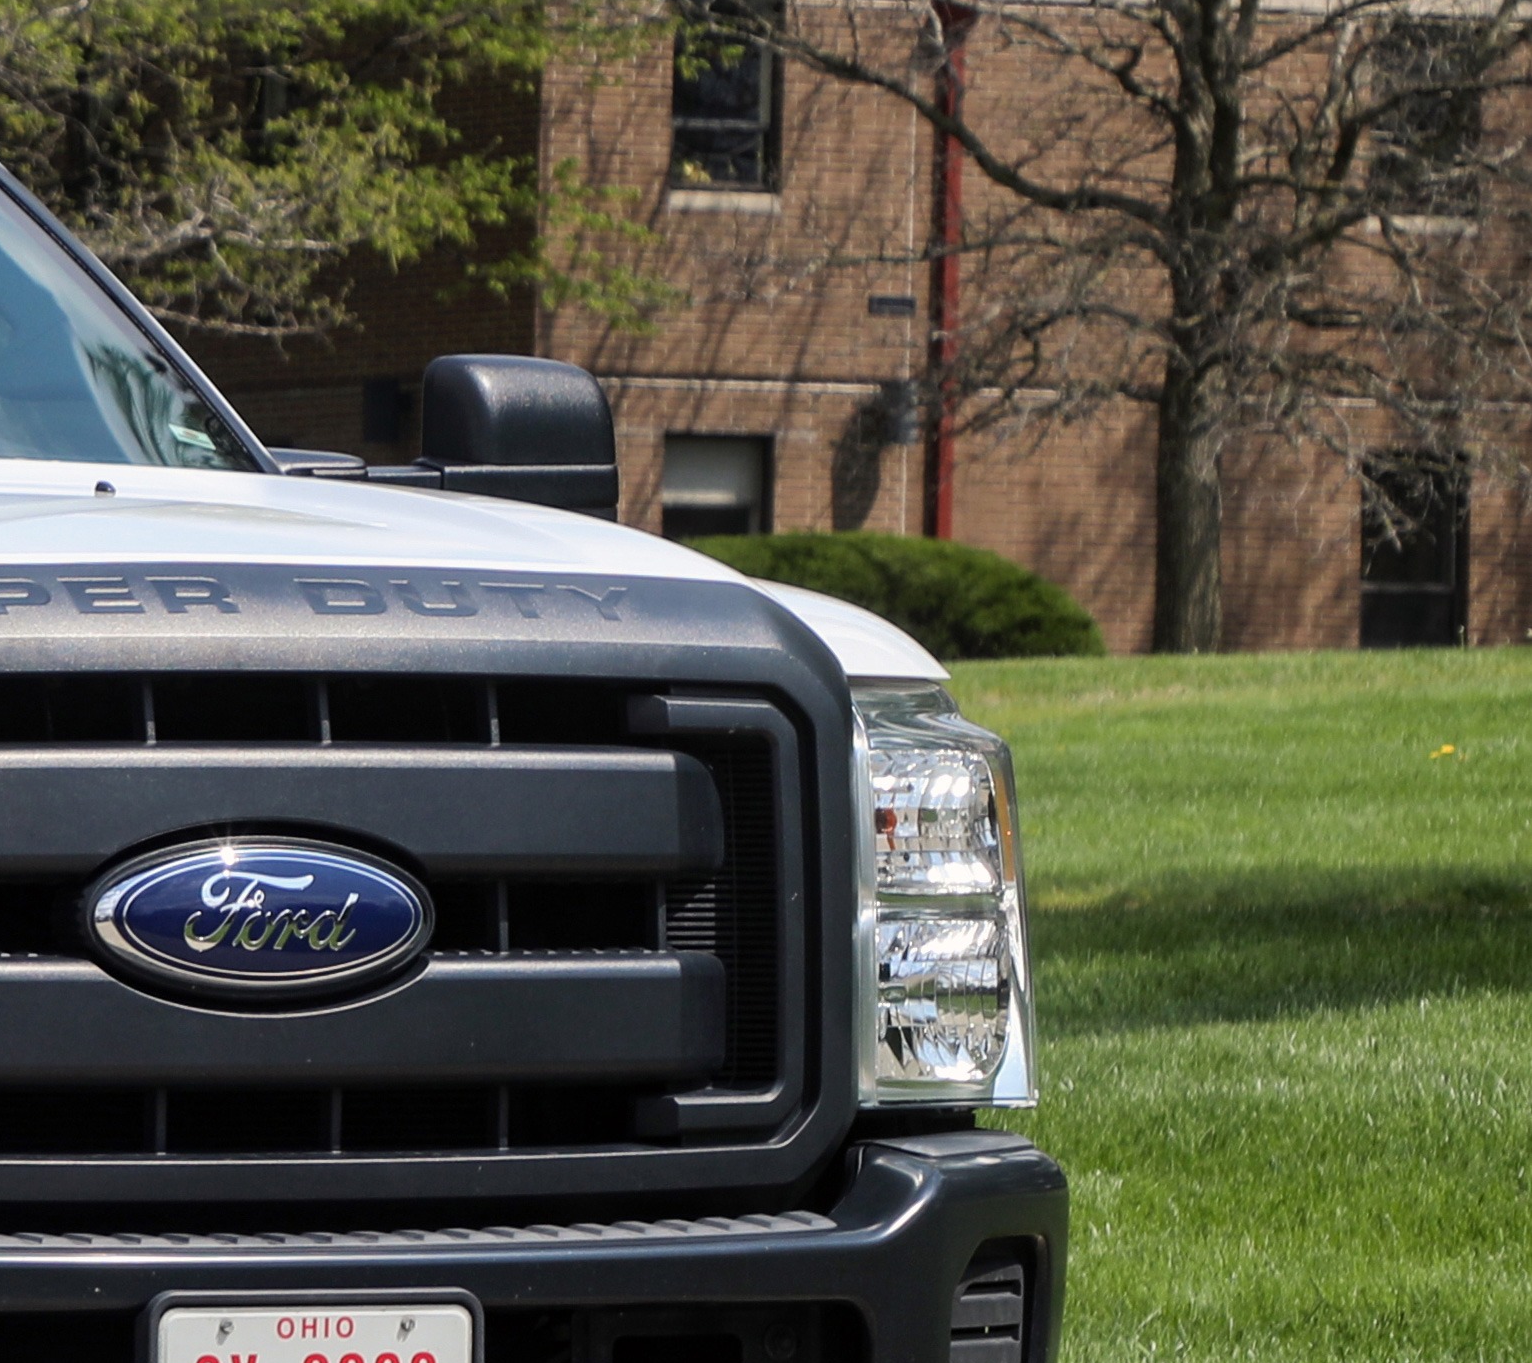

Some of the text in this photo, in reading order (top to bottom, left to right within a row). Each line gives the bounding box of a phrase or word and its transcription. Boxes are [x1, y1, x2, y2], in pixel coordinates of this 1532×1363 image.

[294, 577, 628, 622] DUTY
[184, 870, 360, 952] Ford
[276, 1316, 355, 1340] OHIO
